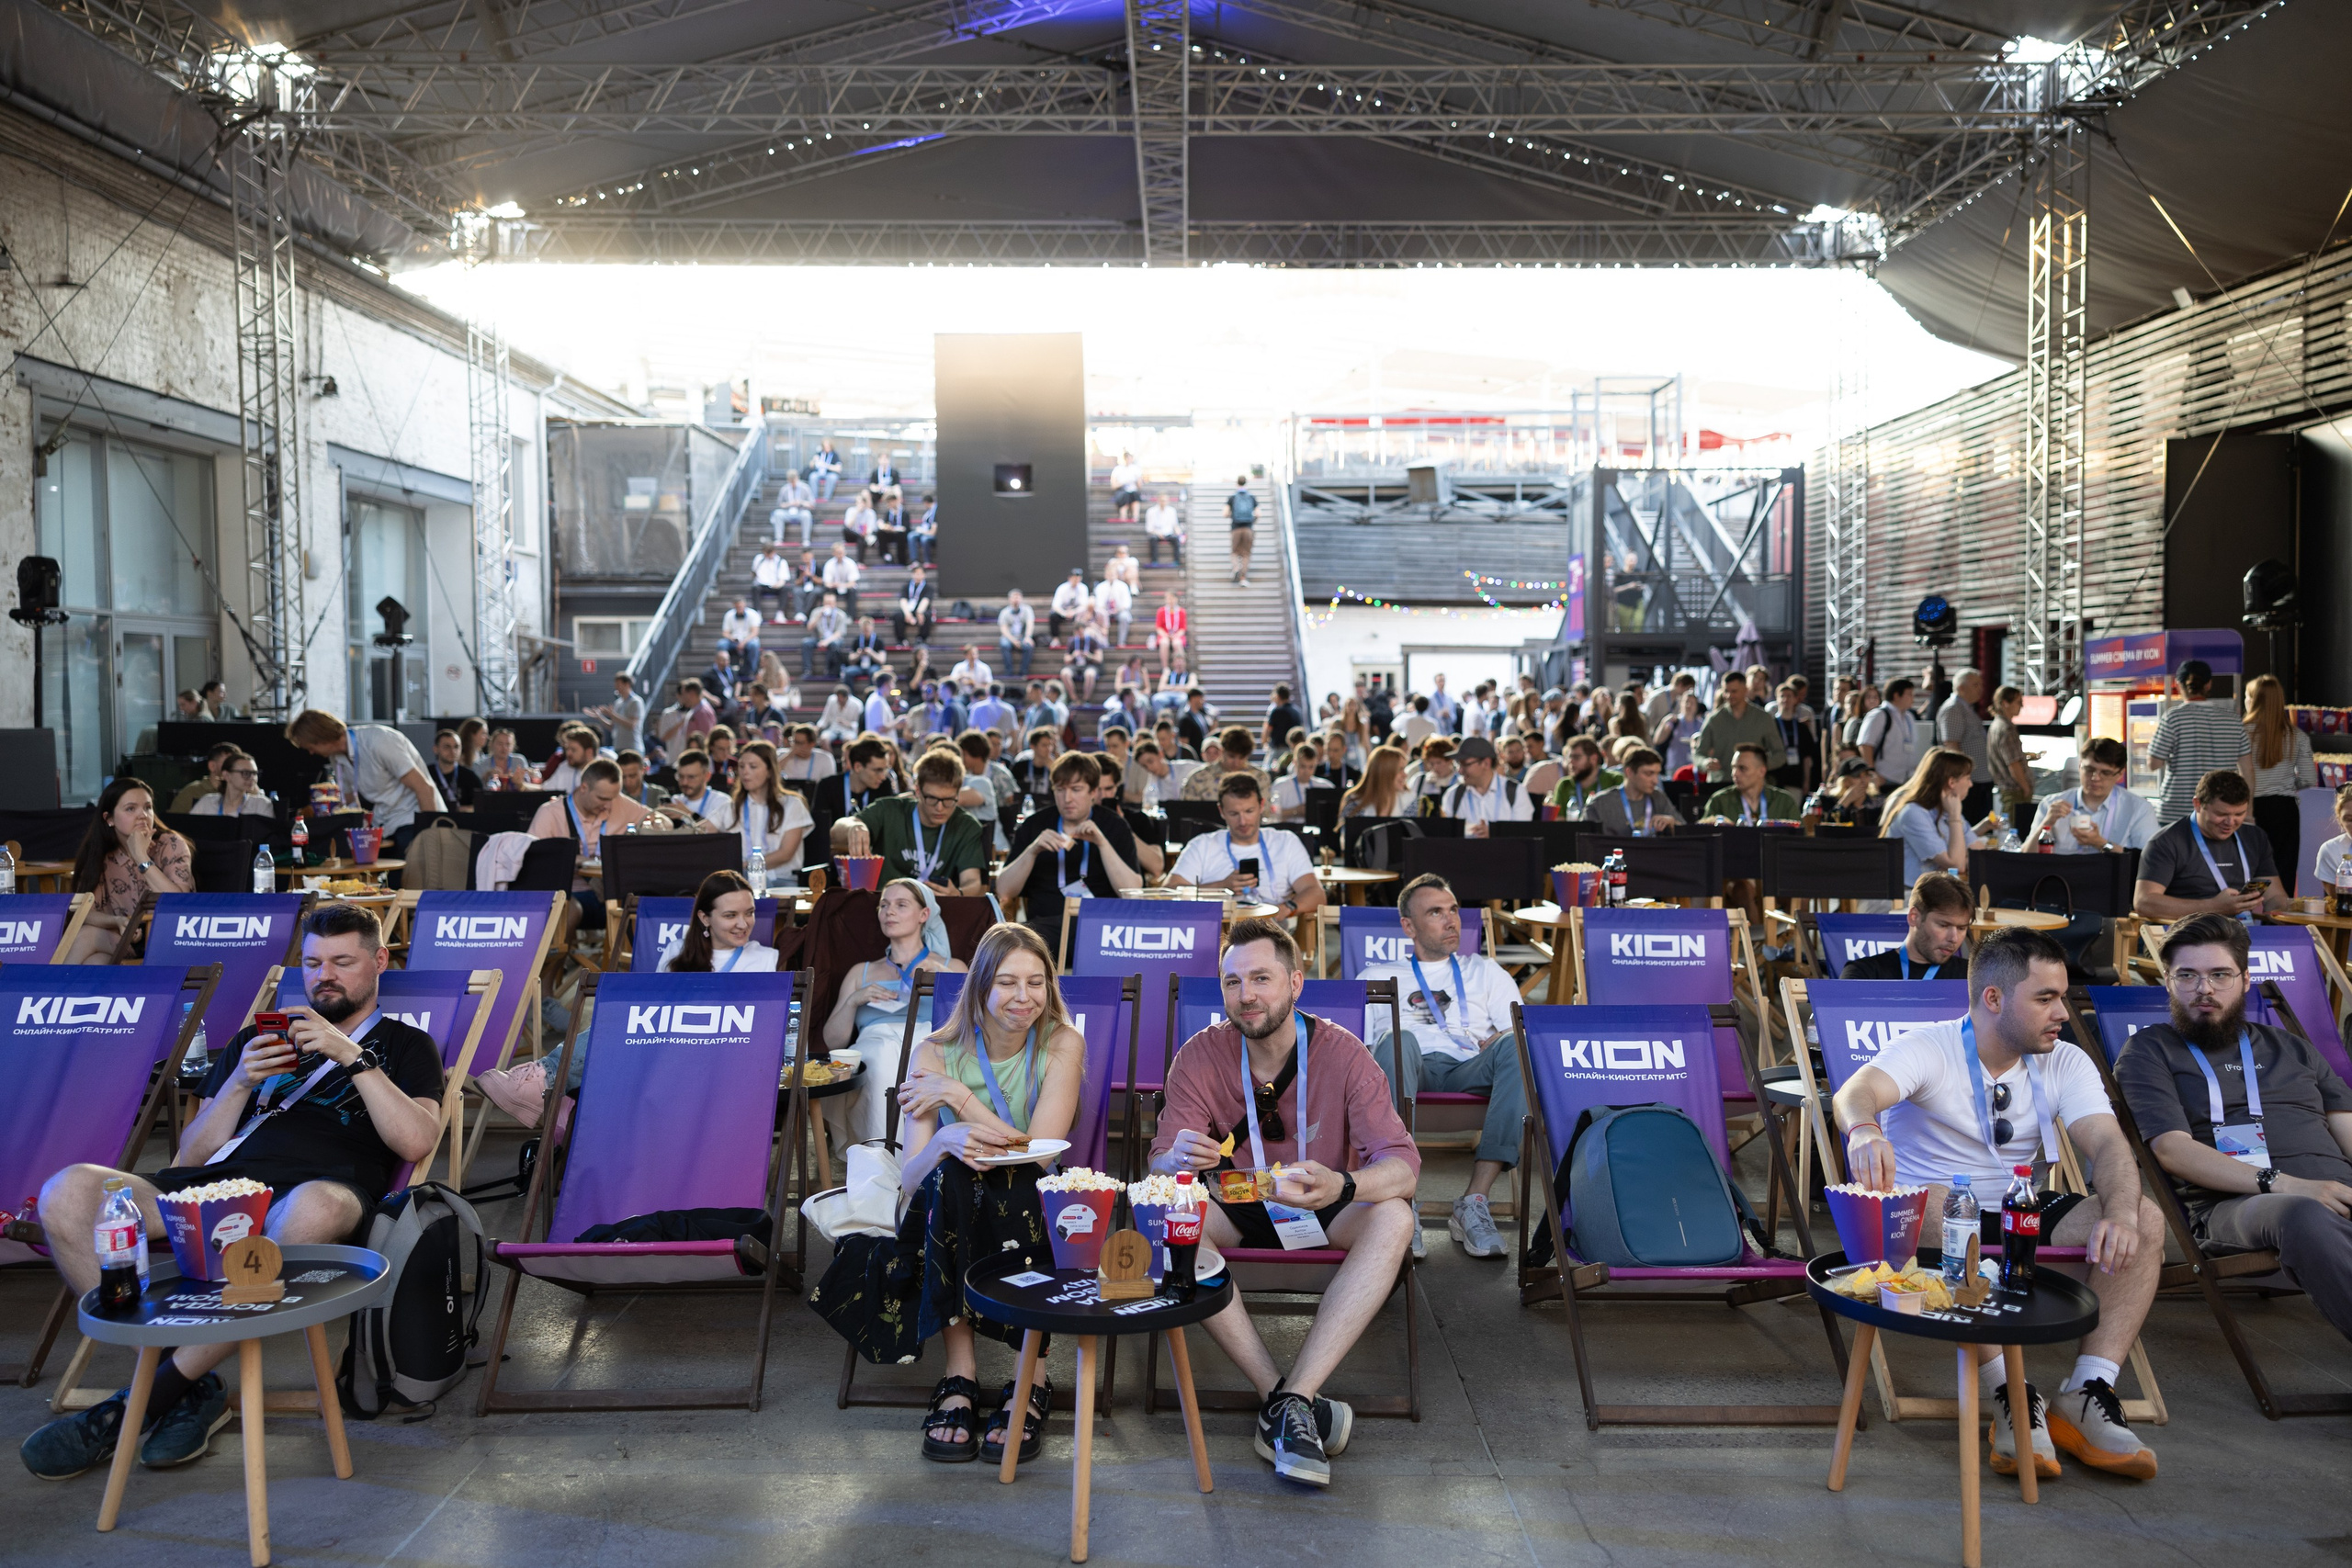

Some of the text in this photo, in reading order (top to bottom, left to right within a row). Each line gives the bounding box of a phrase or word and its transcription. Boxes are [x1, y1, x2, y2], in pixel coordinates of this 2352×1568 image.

[2090, 648, 2159, 665] SUMMER CINEMA BY KION
[175, 916, 272, 939] KION
[435, 916, 527, 940] KION
[1101, 924, 1195, 951] KION
[1611, 933, 1706, 958] KION
[1100, 950, 1176, 959] ОНЛАЙН-КИНОТЕАТР
[17, 996, 146, 1025] KION
[627, 1005, 755, 1034] KION
[13, 1026, 112, 1035] ОНЛАЙН-КИНОТЕАТР
[625, 1036, 728, 1045] ОНЛАЙН-КИНОТЕАТР
[1559, 1039, 1686, 1070] KION
[1564, 1071, 1688, 1081] ОНЛАЙН-КИНОТЕАТР МТС
[1229, 1188, 1250, 1197] NACHOS
[165, 1213, 187, 1224] SUMMER
[1890, 1208, 1915, 1219] SUMMER
[1900, 1213, 1920, 1224] CINEMA
[175, 1223, 197, 1232] CINEMA
[243, 1250, 263, 1275] 4
[1117, 1246, 1135, 1270] 5
